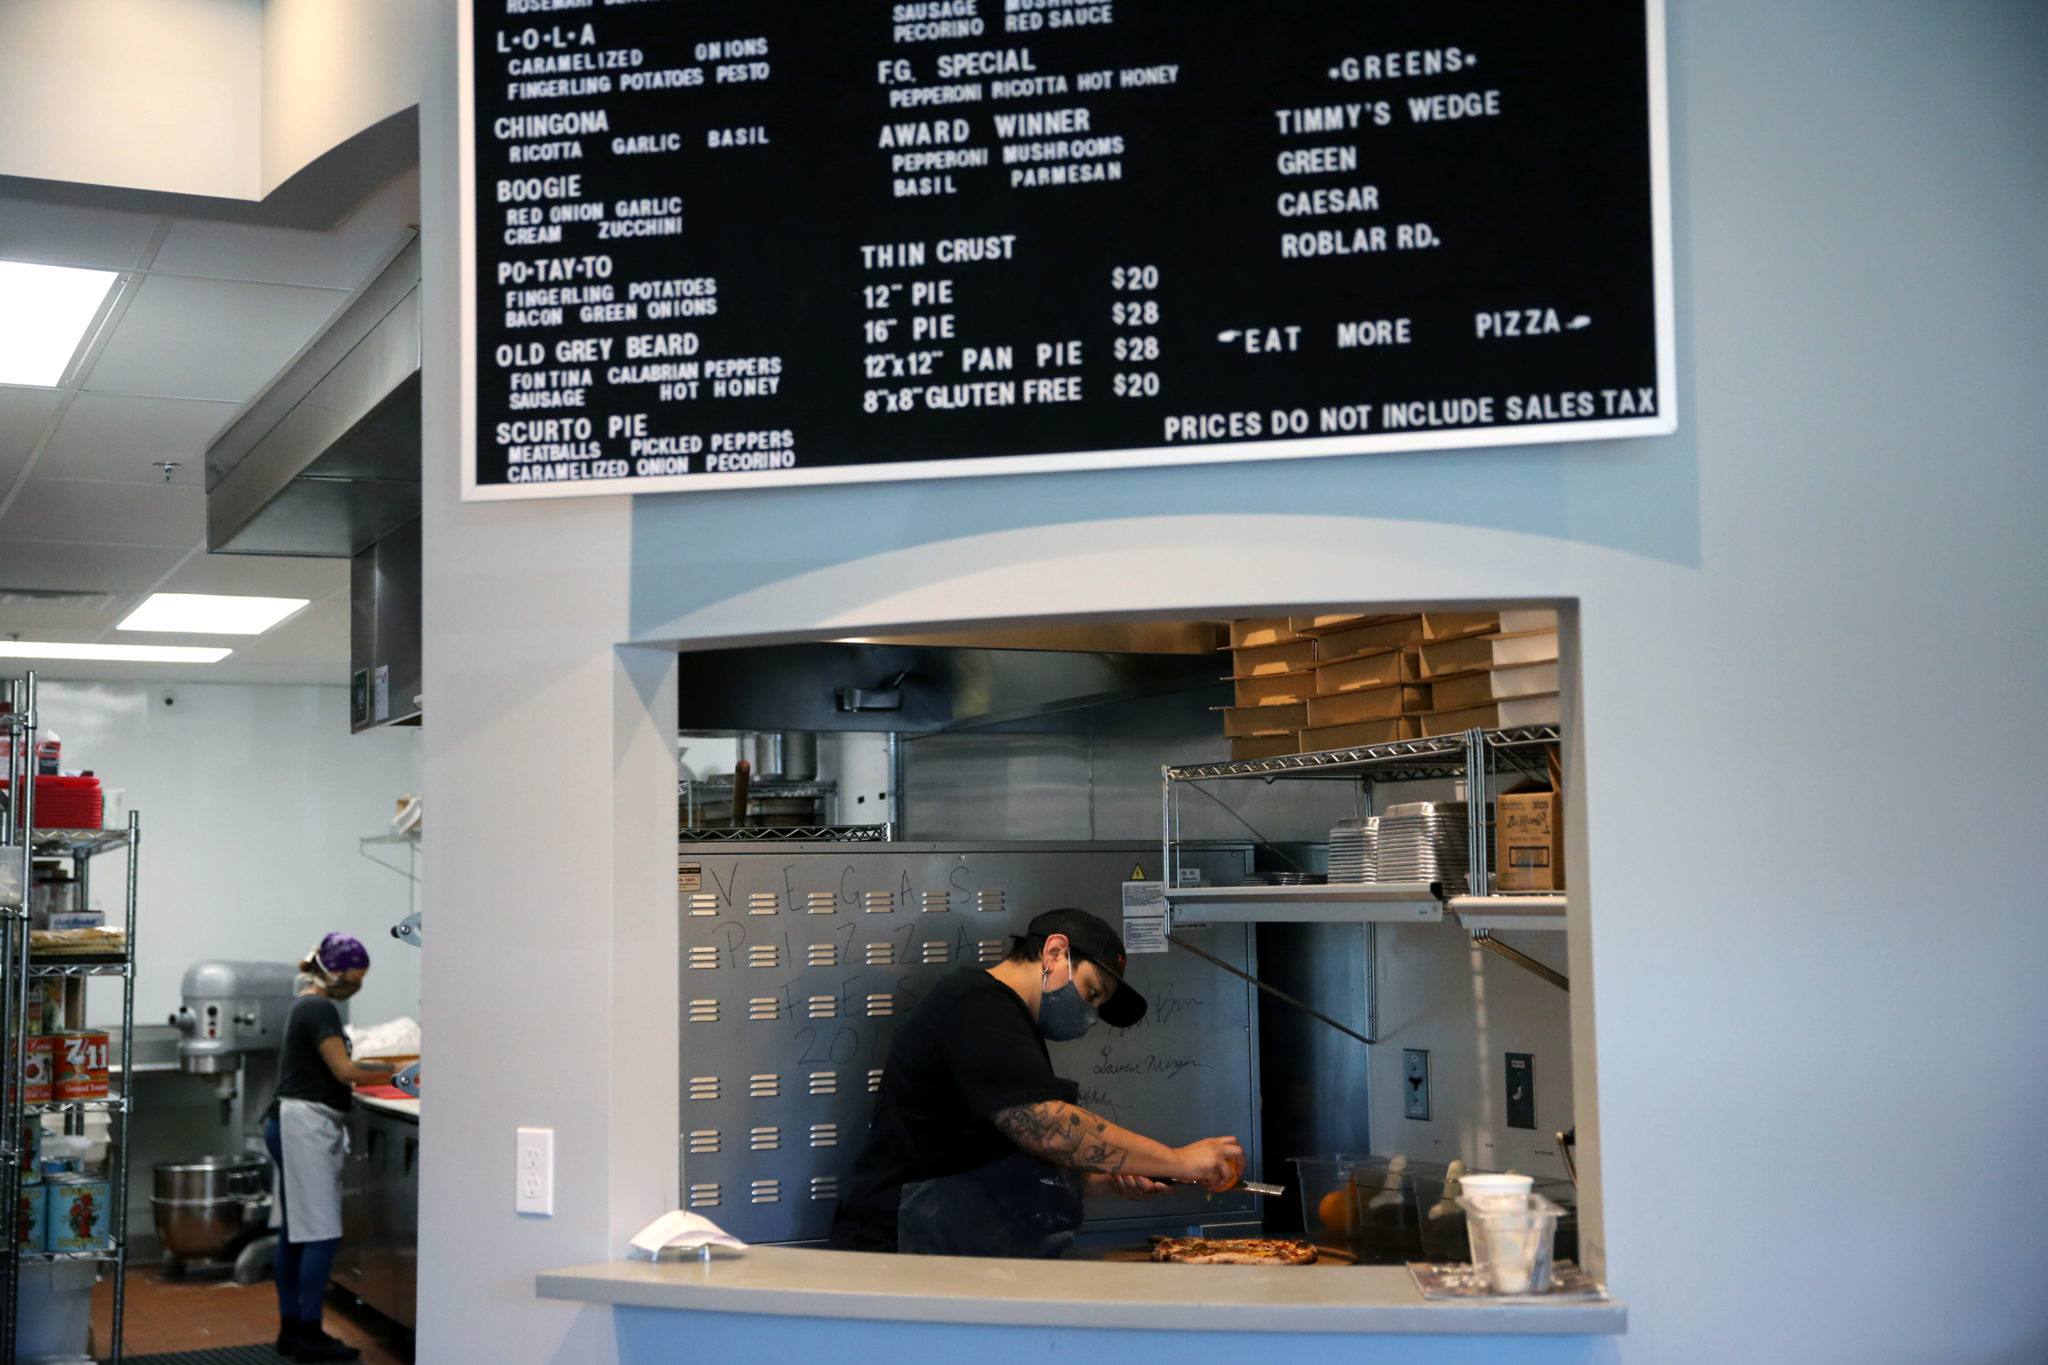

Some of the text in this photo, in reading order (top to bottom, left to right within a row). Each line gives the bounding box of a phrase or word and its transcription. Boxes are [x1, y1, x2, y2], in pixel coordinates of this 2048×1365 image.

[892, 0, 978, 23] SAUSAGE
[893, 5, 1113, 43] PECORINO RED SAUCE
[508, 37, 769, 76] CARAMELIZED ONIONS
[877, 48, 1036, 85] F.G. SPECIAL
[508, 62, 770, 100] FINGERLING POTATOES PESTO
[889, 64, 1179, 109] PEPPERONI RICOTTA HOT HONEY
[494, 110, 609, 140] CHINGONA
[878, 108, 1090, 149] AWARD WINNER
[1276, 90, 1500, 135] TIMMY'S WEDGE
[509, 126, 770, 163] RICOTTA GARLIC BASIL
[892, 136, 1125, 173] PEPPERONI MUSHROOMS
[1277, 146, 1356, 176] GREEN
[497, 175, 582, 203] BOOGIE
[893, 161, 1122, 198] BASIL PARMESAN
[506, 197, 682, 226] RED ONION GARLIC
[1277, 186, 1379, 217] CAESAR
[504, 217, 683, 245] CREAM ZUCCHINI
[1281, 224, 1440, 259] ROBLAR RD.
[860, 235, 1016, 269] THIN CRUST
[505, 277, 717, 309] FINGERLING POTATOES
[912, 280, 953, 306] PIE
[1111, 265, 1159, 291] $20
[505, 298, 718, 328] BACON GREEN ONIONS
[912, 314, 955, 341] PIE
[1112, 300, 1160, 326] $28
[1245, 308, 1561, 353] EAT MORE PIZZA
[495, 332, 699, 367] OLD GREY BEARD
[961, 346, 1013, 373] PAN
[1036, 341, 1083, 368] PIE
[1113, 335, 1160, 362] $28
[510, 356, 782, 391] FONTINA CALABRIAN PEPPERS
[925, 381, 1015, 409] GLUTEN
[1022, 376, 1083, 404] FREE
[1113, 371, 1160, 398] $20
[509, 377, 781, 410] SAUSAGE HOT HONEY
[496, 414, 648, 445] SCURTO PIE
[1164, 388, 1656, 442] PRICES DO NOT INCLUDE SALES TAX
[508, 429, 794, 464] MEATBALLS PICKLED PEPPERS
[507, 449, 795, 483] CARAMELIZED ONION PECORINO
